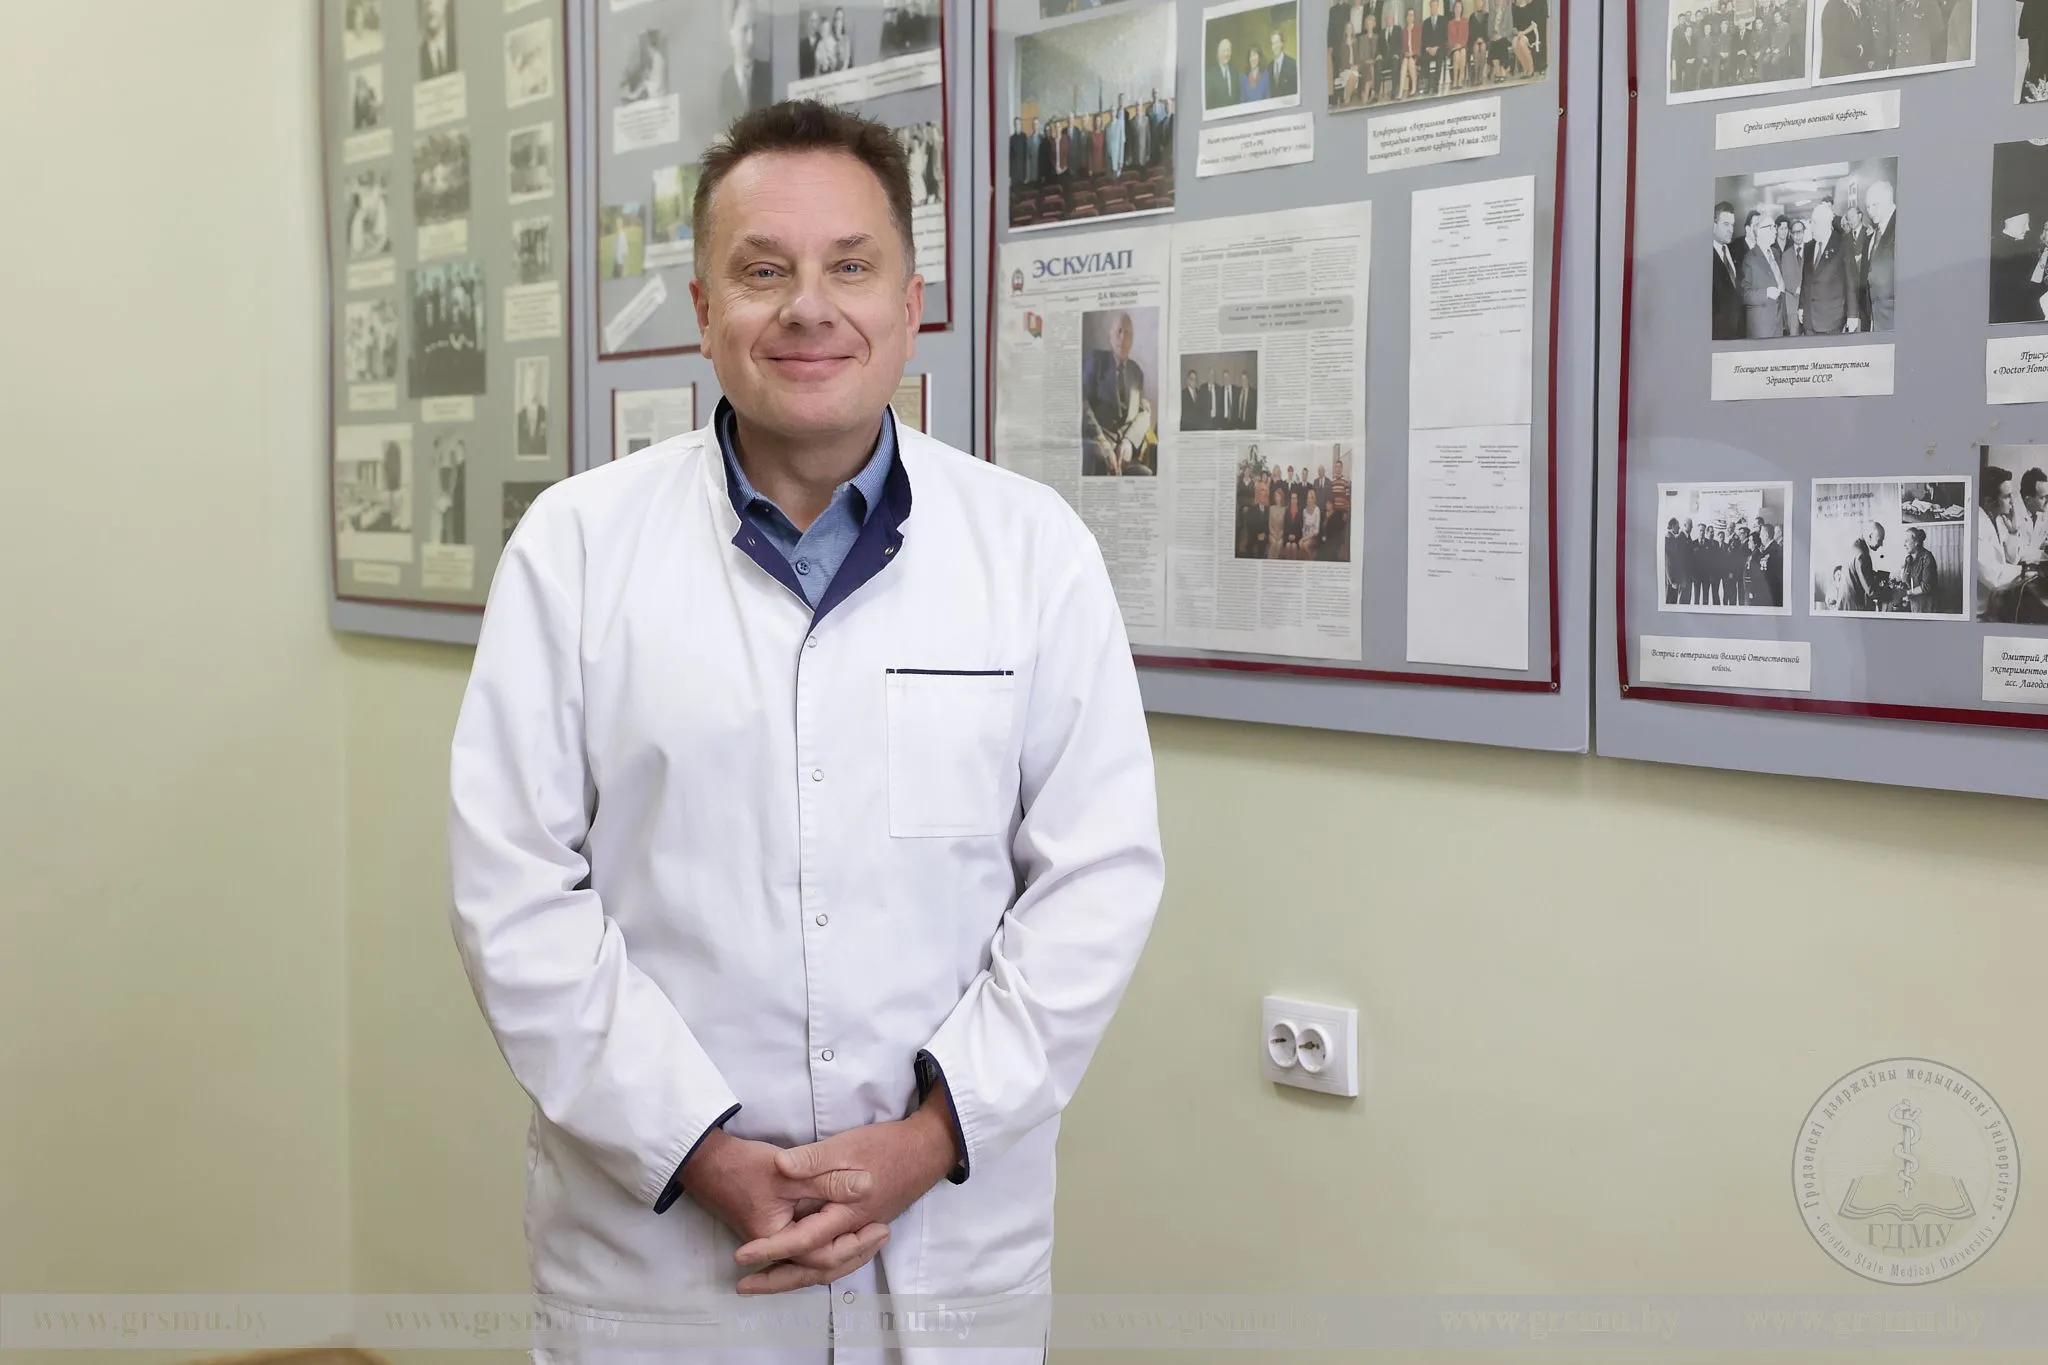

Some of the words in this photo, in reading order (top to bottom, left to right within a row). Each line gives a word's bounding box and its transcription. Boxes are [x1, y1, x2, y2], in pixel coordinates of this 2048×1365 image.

[1743, 121, 1763, 134] Среди
[1763, 117, 1807, 131] сотрудников
[1807, 113, 1834, 125] военной
[1835, 108, 1868, 122] кафедры.
[1032, 249, 1134, 279] ЭСКУЛАП
[1733, 364, 1769, 375] Посещение
[1769, 362, 1809, 375] института
[1999, 366, 2025, 375] Doctor
[1811, 373, 1834, 385] СССР.
[1651, 649, 1675, 661] Встреча
[1679, 651, 1719, 661] ветеранами
[1719, 652, 1747, 663] Великой
[1747, 653, 1800, 664] Отечественной
[2001, 651, 2040, 665] Дмитрий
[1990, 665, 2048, 677] экспериментов
